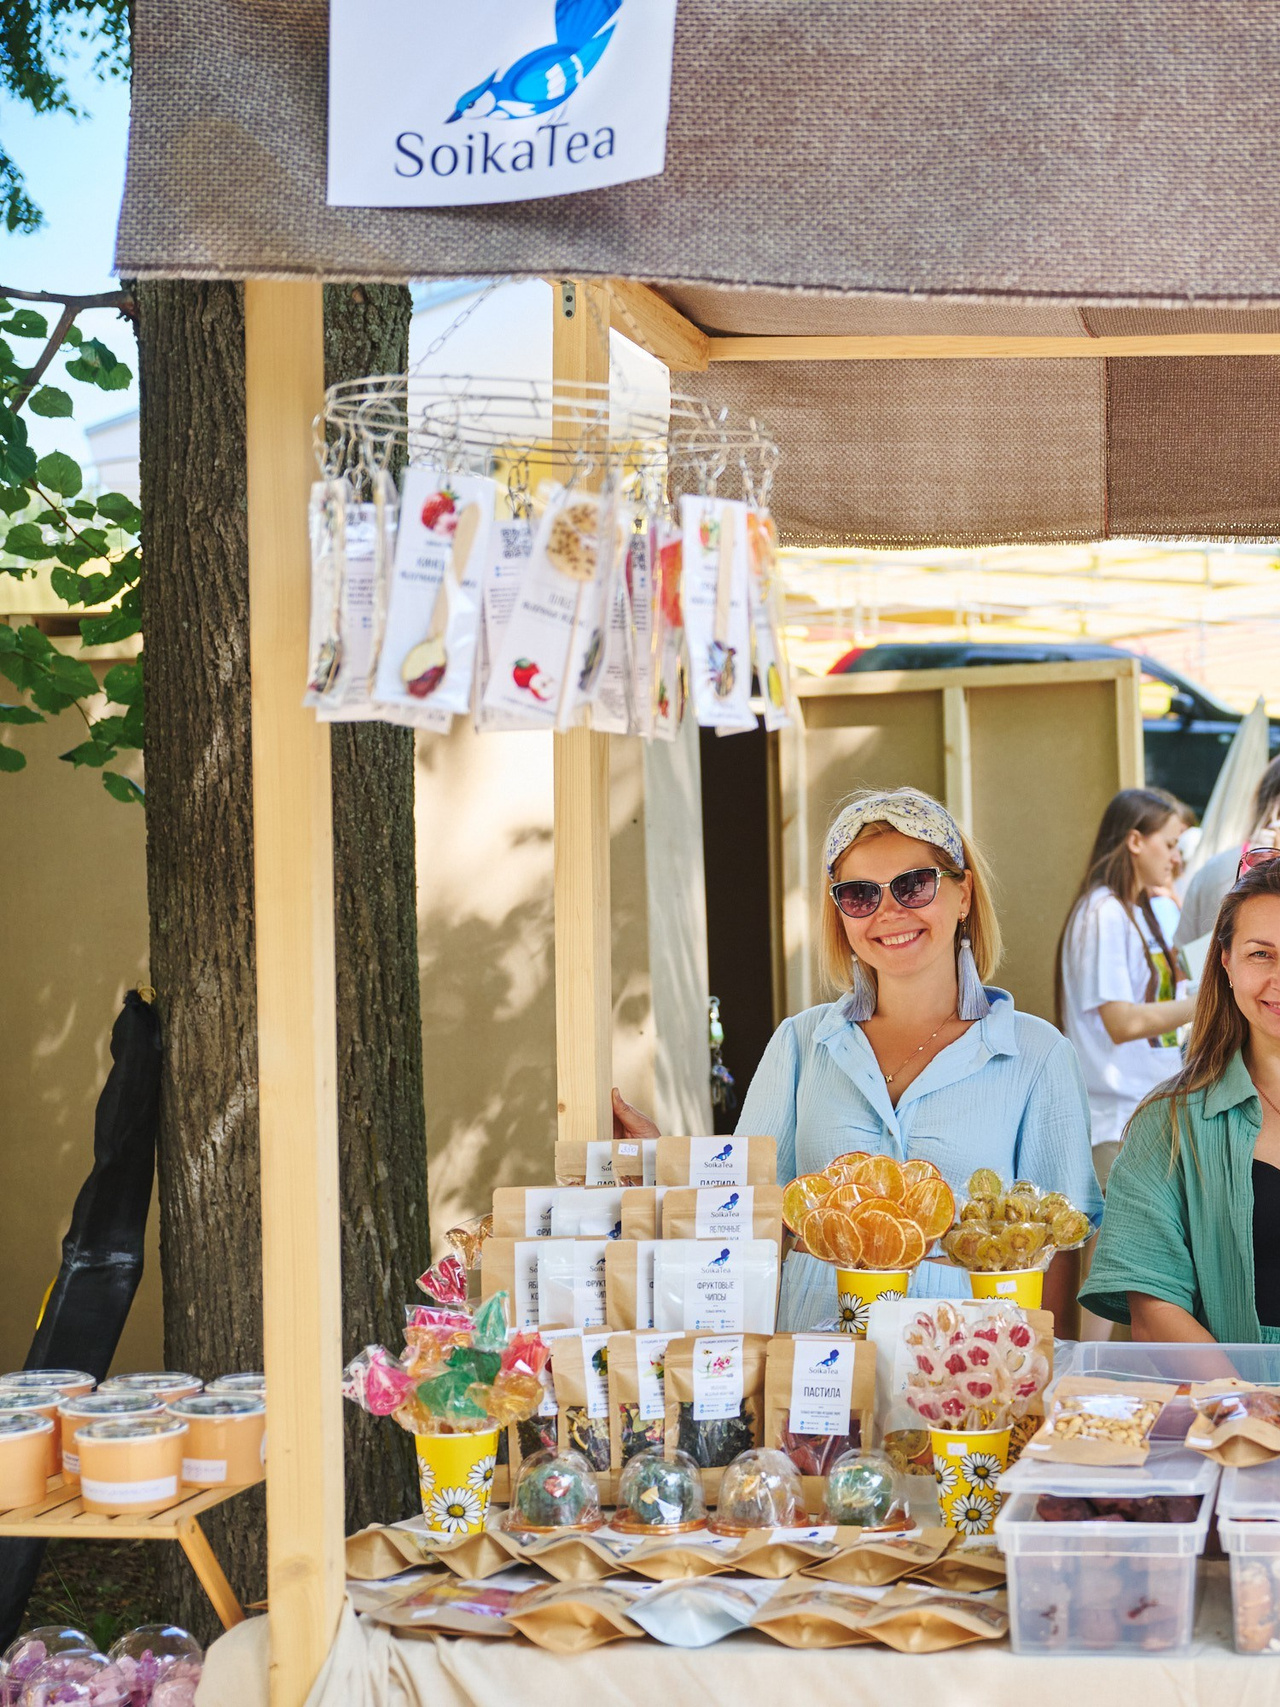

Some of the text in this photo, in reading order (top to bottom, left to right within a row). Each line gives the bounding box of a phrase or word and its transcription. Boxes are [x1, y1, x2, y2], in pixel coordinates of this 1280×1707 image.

[394, 121, 616, 178] SoikaTea
[703, 1161, 733, 1169] SoikaTea
[710, 1210, 740, 1218] SoikaTea
[701, 1266, 731, 1274] SoikaTea
[696, 1281, 735, 1290] ФРУКТОВЫЕ
[704, 1292, 727, 1301] ЧИПСЫ
[808, 1366, 839, 1375] SoikaTea
[803, 1386, 841, 1398] ПАСТИЛА
